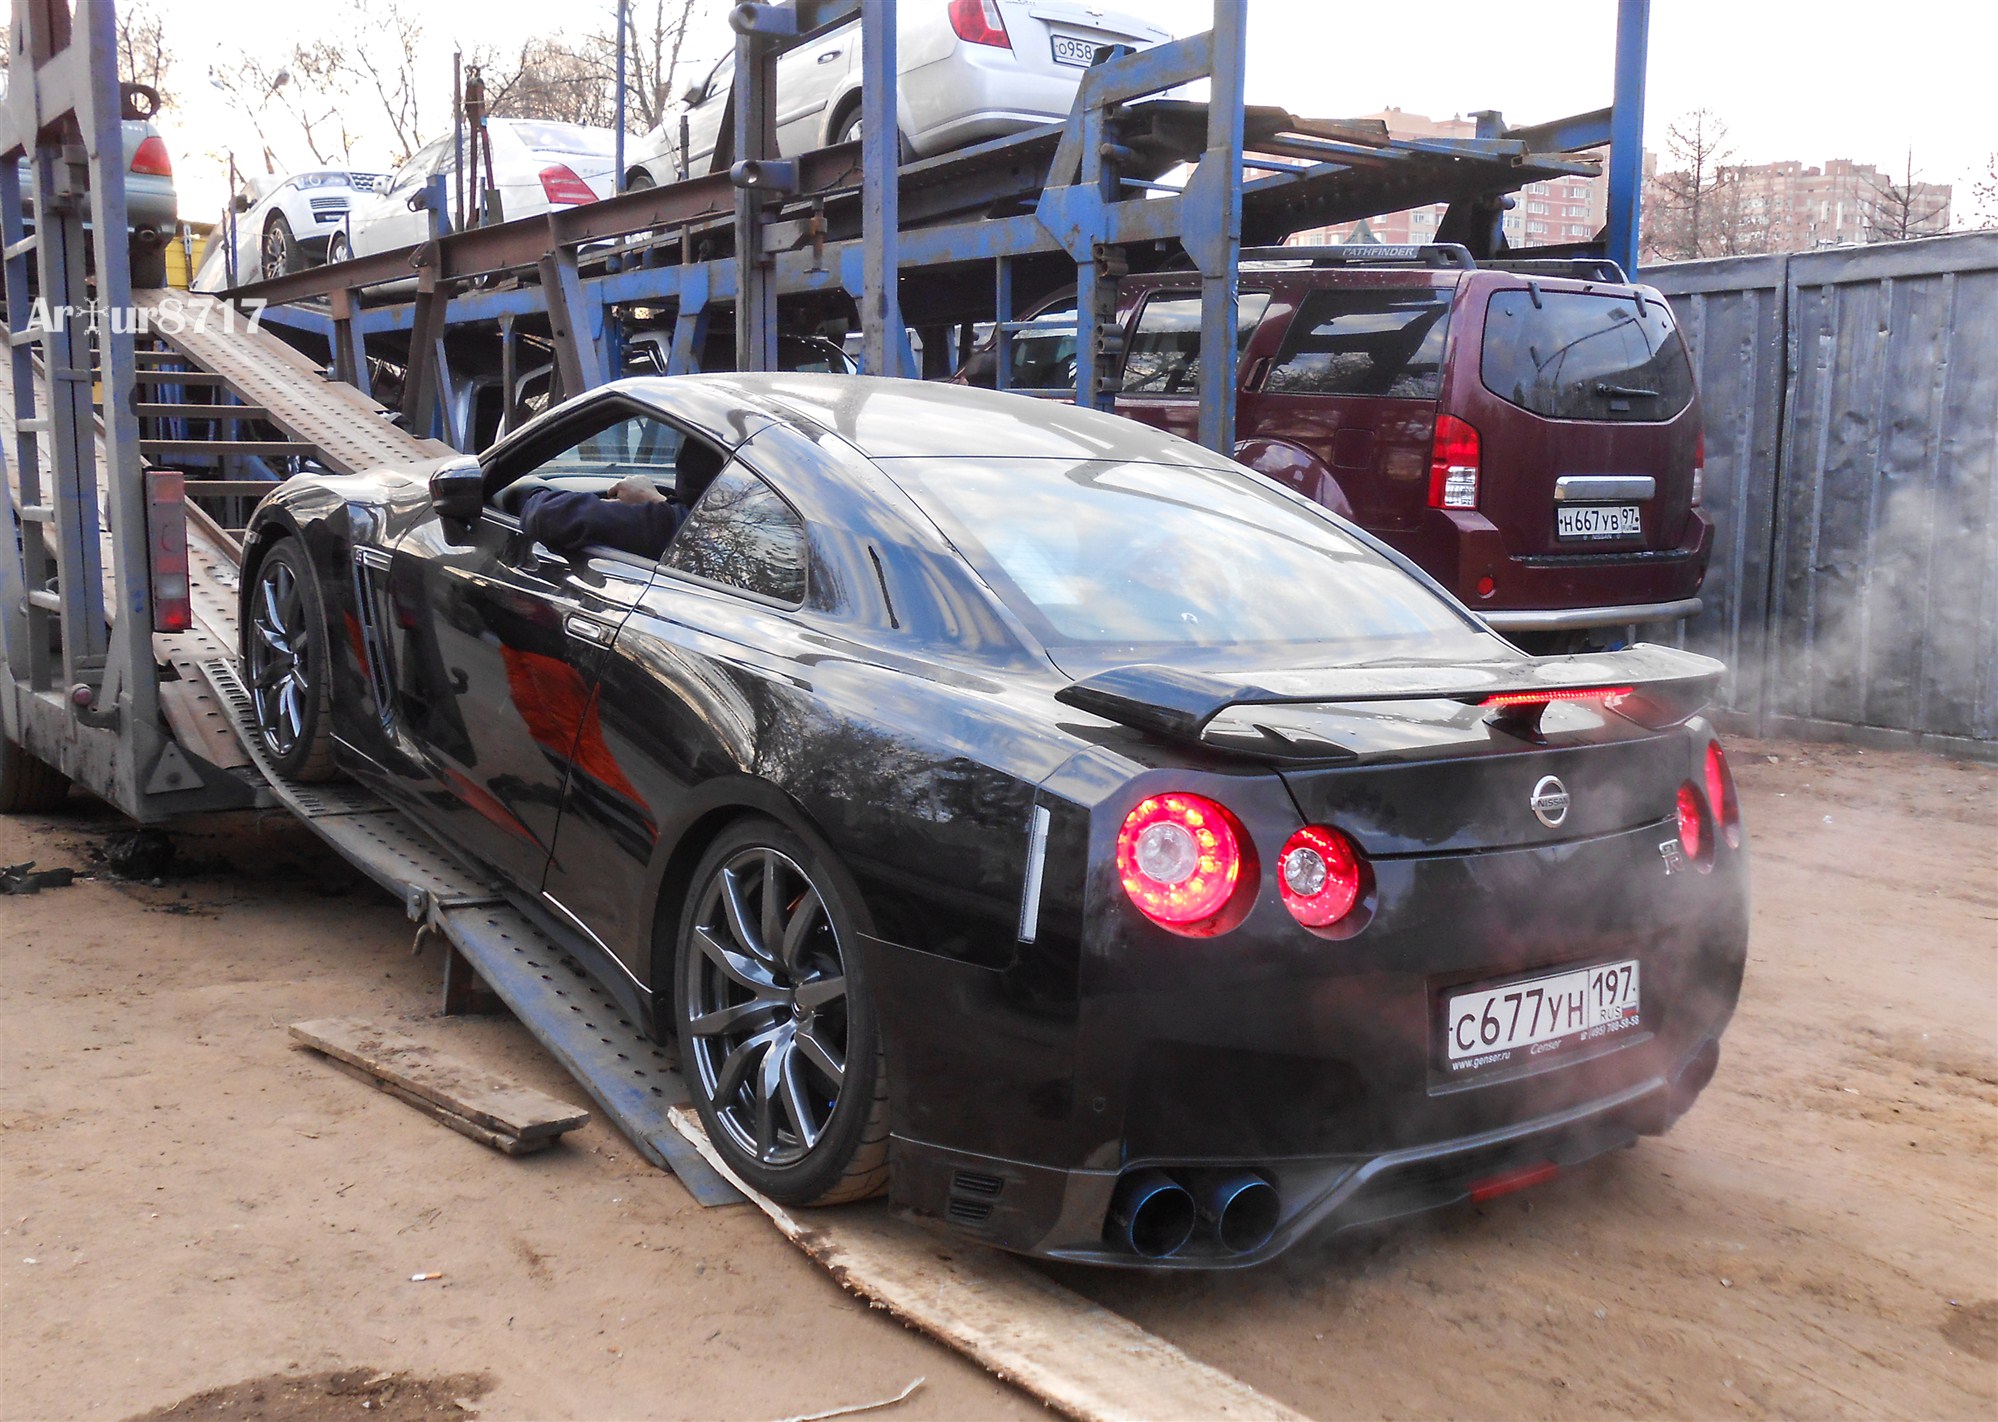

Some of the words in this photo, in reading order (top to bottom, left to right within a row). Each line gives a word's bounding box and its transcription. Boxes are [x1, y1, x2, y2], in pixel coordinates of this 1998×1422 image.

[1342, 247, 1415, 257] PATHFINDER
[1622, 508, 1635, 524] 97
[1537, 797, 1569, 808] NISSAN
[1456, 988, 1584, 1050] С677УН
[1592, 965, 1632, 1007] 197
[1600, 1005, 1622, 1021] RUS
[1452, 1051, 1511, 1072] www.genser.ru
